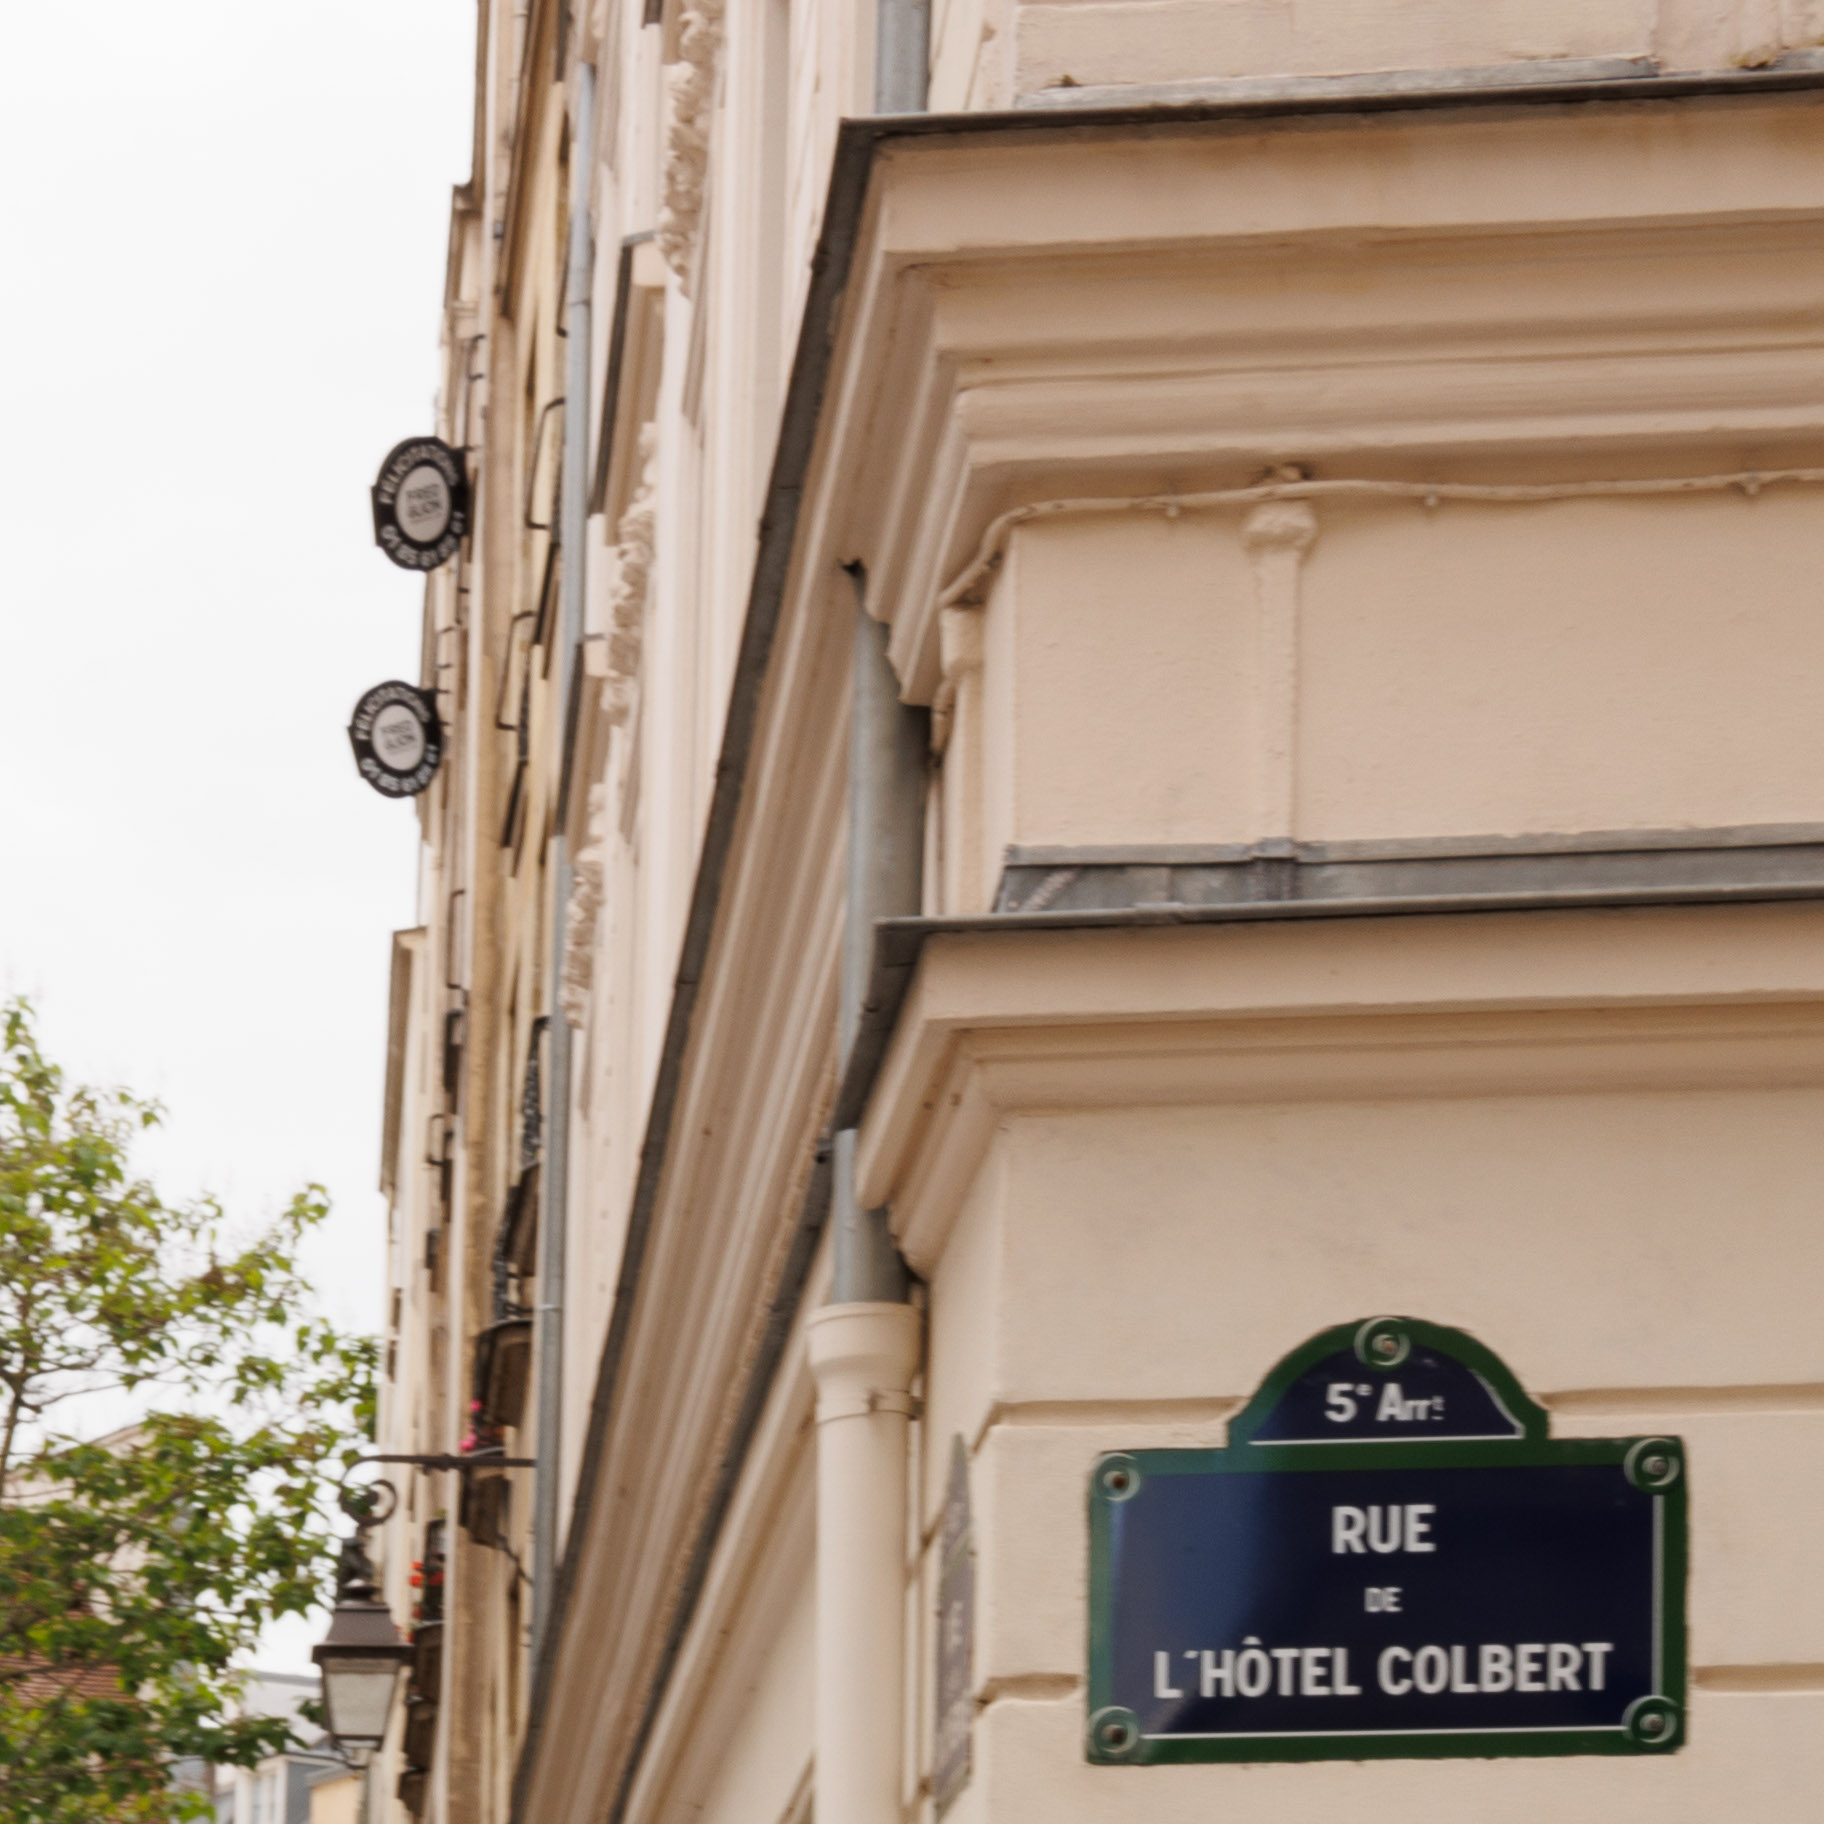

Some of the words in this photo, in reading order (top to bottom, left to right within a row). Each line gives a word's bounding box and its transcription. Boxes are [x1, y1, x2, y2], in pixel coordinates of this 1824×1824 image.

[1332, 1503, 1436, 1554] RUE
[1364, 1586, 1402, 1613] DE
[1153, 1636, 1362, 1700] L'HÔTEL
[1377, 1642, 1614, 1696] COLBERT
